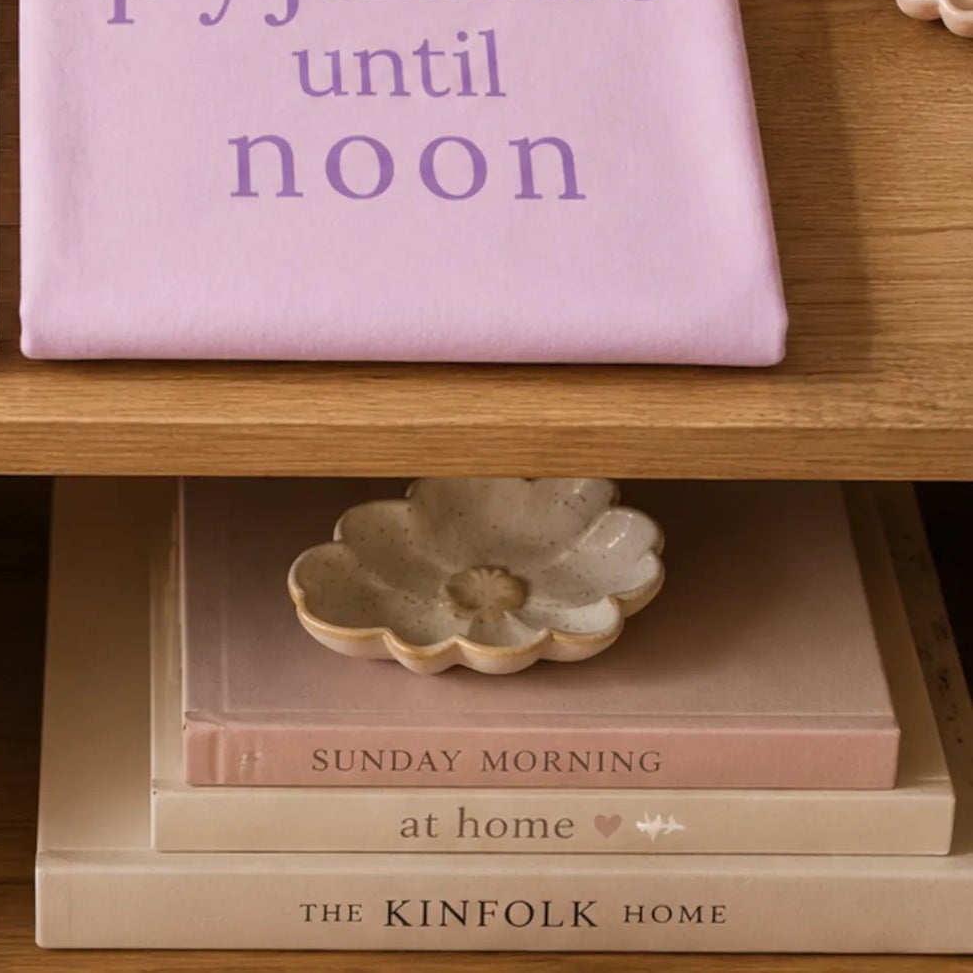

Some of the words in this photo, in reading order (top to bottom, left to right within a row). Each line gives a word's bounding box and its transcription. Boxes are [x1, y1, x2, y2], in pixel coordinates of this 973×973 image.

[291, 29, 508, 99] until
[227, 134, 587, 202] noon
[311, 748, 463, 774] SUNDAY
[480, 749, 664, 774] MORNING
[399, 812, 440, 840] at
[455, 805, 576, 840] home
[299, 902, 364, 923] THE
[384, 898, 599, 929] KINFOLK
[623, 904, 728, 925] HOME
